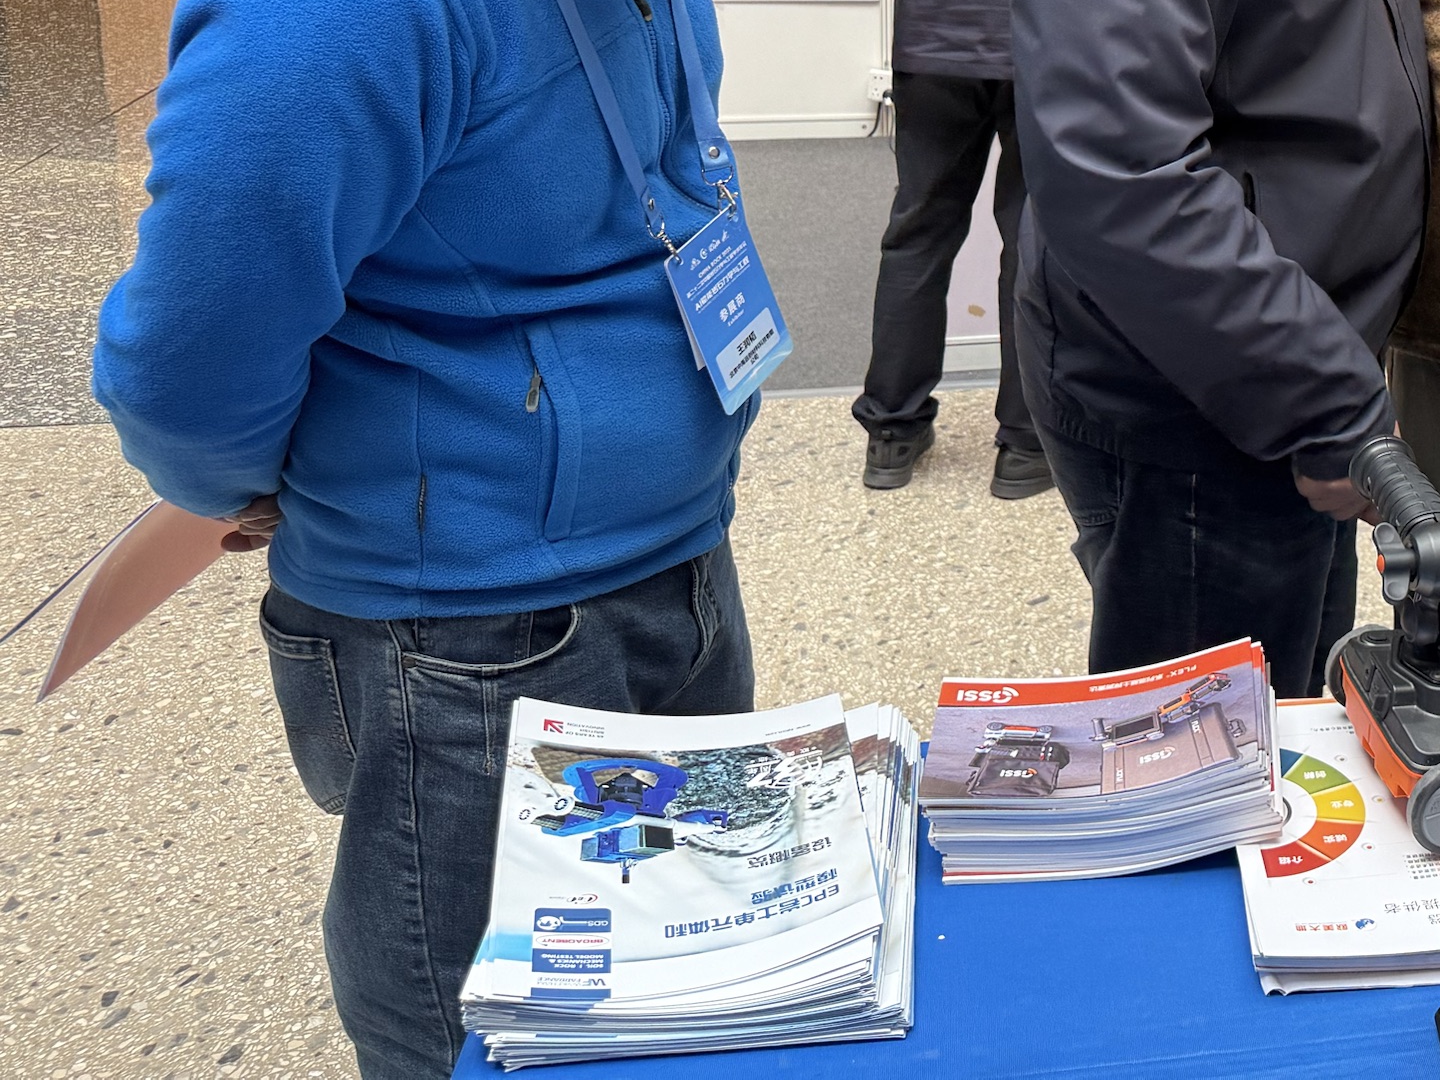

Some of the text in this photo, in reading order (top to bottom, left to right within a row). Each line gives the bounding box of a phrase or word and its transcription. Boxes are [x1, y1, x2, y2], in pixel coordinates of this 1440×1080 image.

[719, 291, 746, 322] 参展商
[1169, 664, 1197, 677] FLEX
[956, 686, 1020, 705] GSSI
[1139, 745, 1176, 766] GSSI
[999, 766, 1039, 780] GSSI
[1303, 769, 1327, 781] 创新
[1331, 799, 1355, 809] 专业
[747, 837, 832, 869] 设备概览
[1278, 855, 1304, 866] 介绍
[750, 868, 838, 905] 模型试验
[664, 884, 840, 939] EPC岩土单元体和
[1295, 922, 1349, 932] 欧美大地
